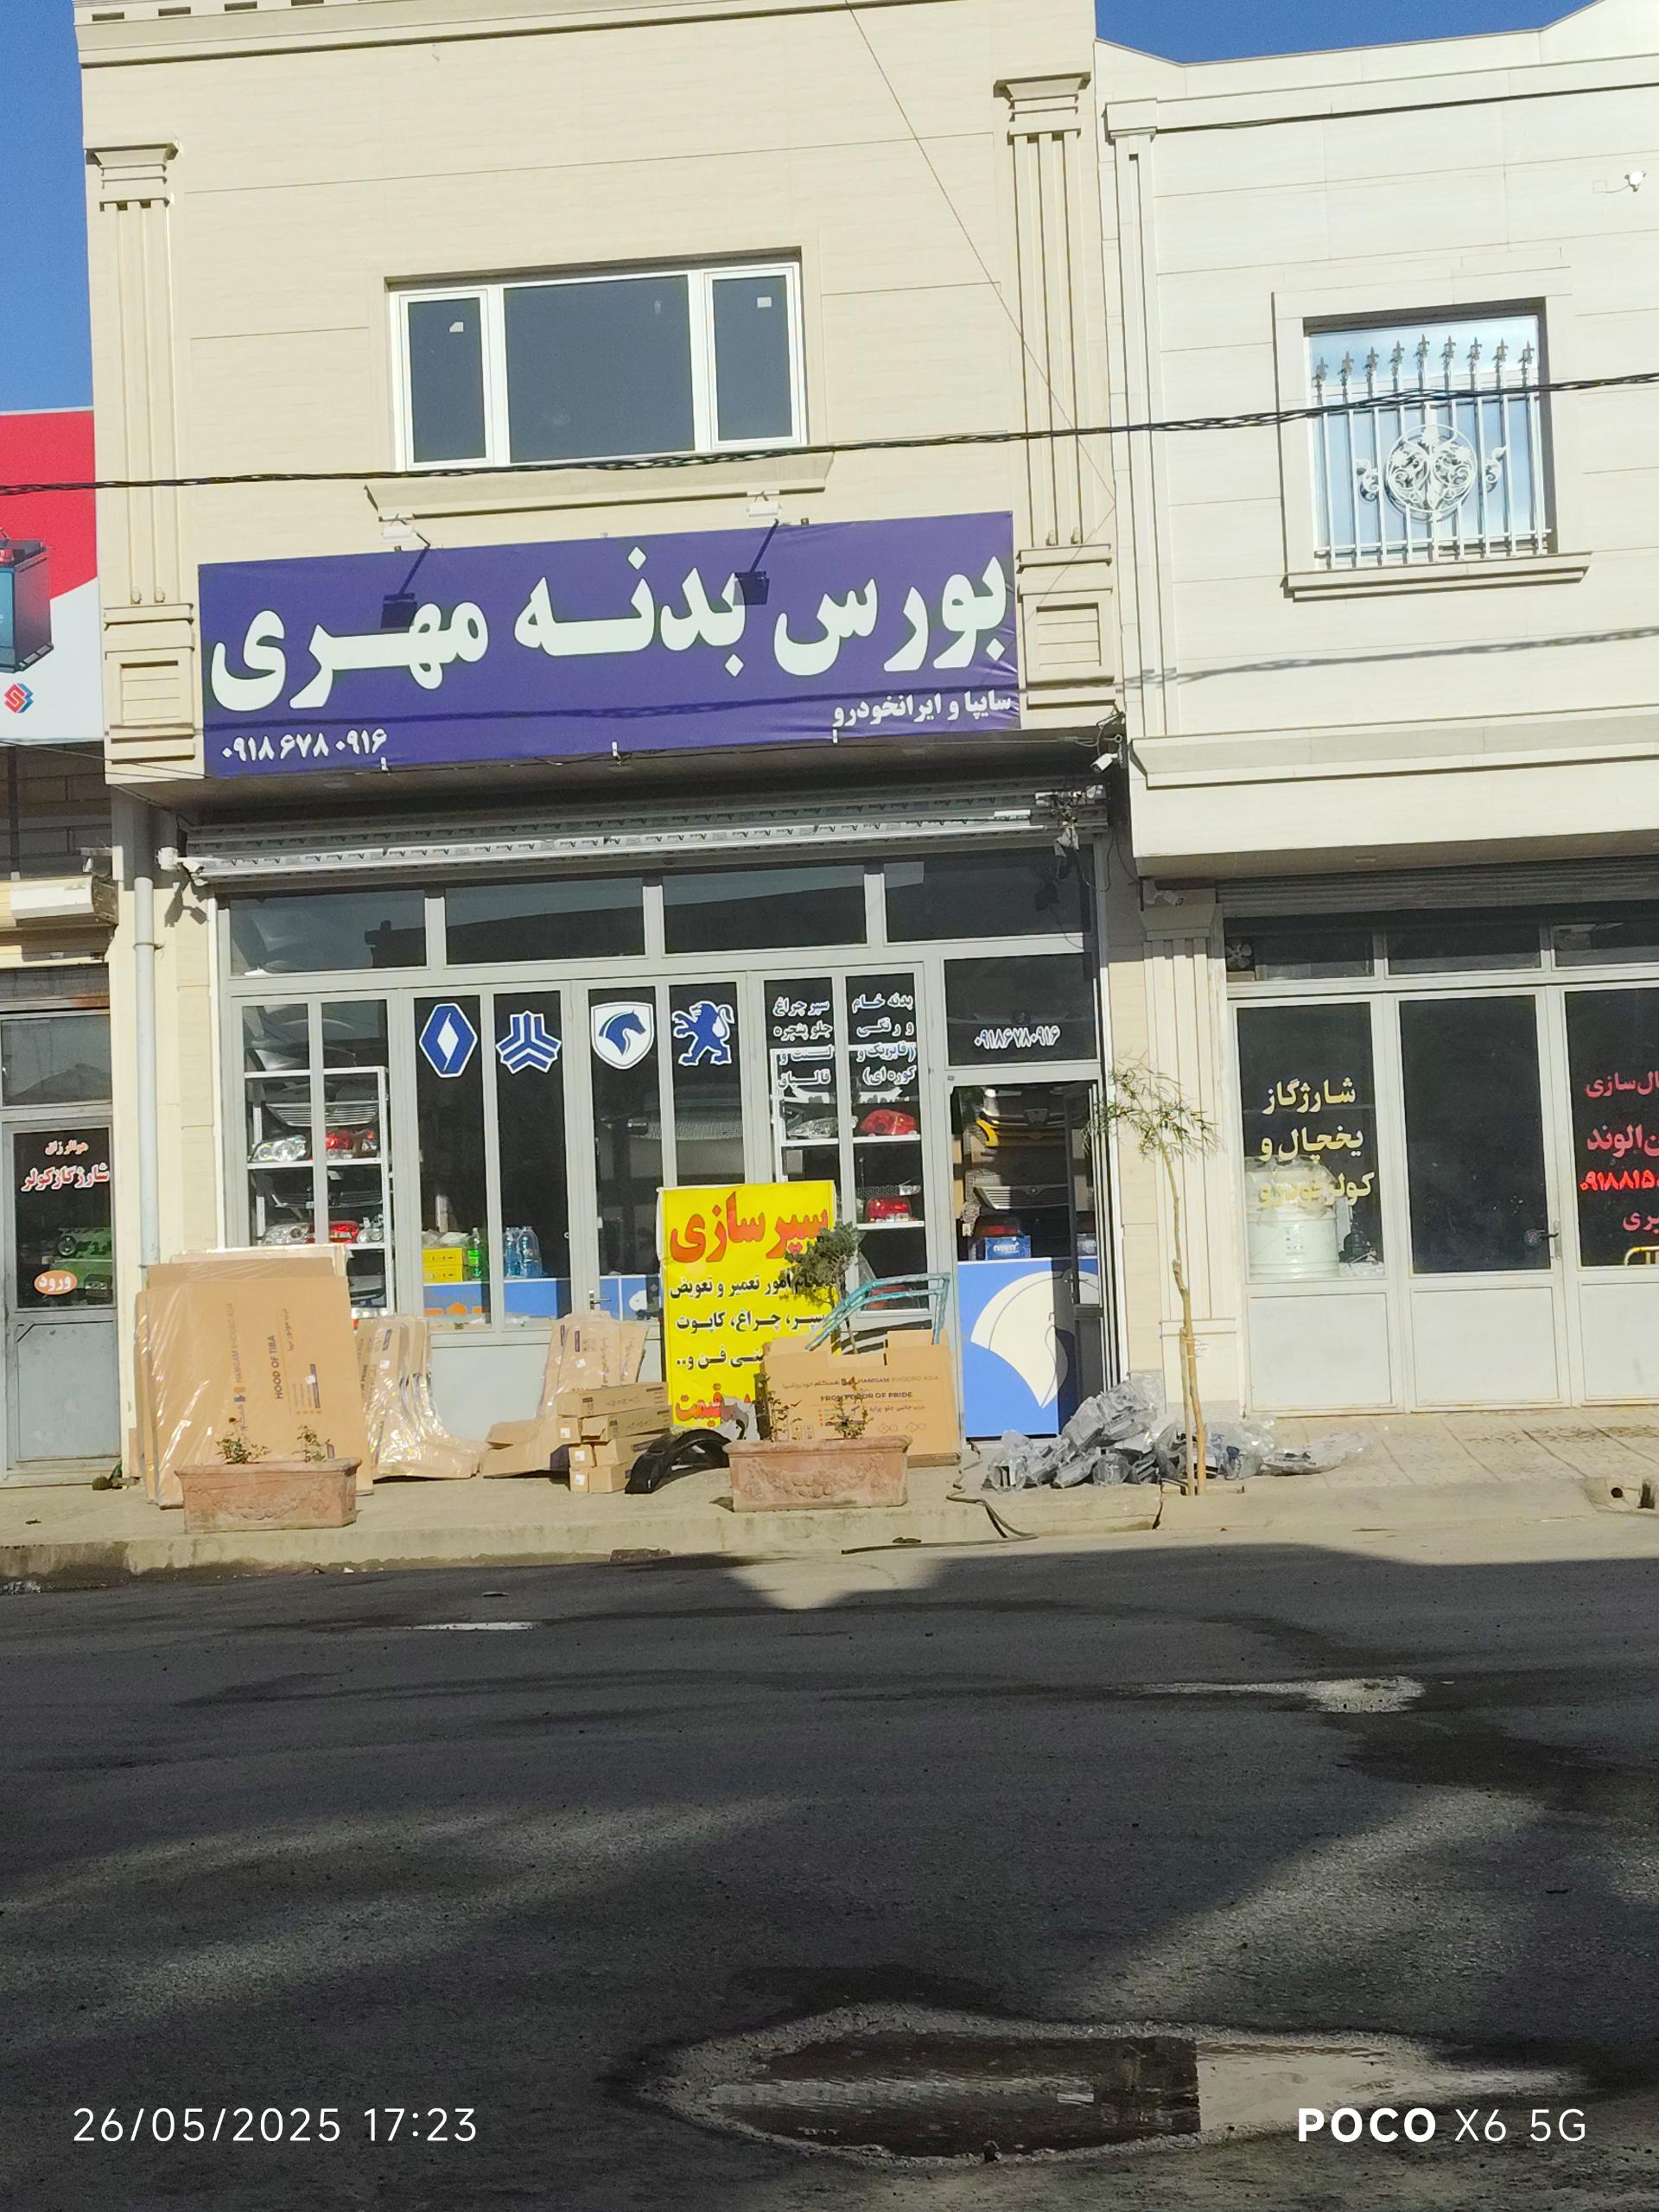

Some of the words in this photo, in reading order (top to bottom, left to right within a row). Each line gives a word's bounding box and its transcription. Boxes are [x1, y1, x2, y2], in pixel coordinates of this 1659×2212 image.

[514, 547, 746, 677] بدنه
[774, 556, 1007, 676] بورس
[211, 601, 489, 711] مهری
[947, 701, 959, 721] و
[964, 690, 1011, 720] سایپا
[772, 996, 807, 1017] چراغ
[852, 993, 886, 1014] خام
[887, 992, 913, 1010] بدنه
[773, 1023, 809, 1041] پنجره
[810, 1020, 833, 1039] جلو
[905, 1021, 914, 1036] و
[1262, 1078, 1300, 1115] گاز
[1297, 1077, 1356, 1113] شارژ
[1258, 1137, 1273, 1161] و
[1278, 1125, 1363, 1164] یخچال
[1586, 1123, 1643, 1158] الوند
[1580, 1169, 1659, 1191] ۰۹۱۸۸۱۵
[670, 1191, 766, 1263] سازی
[766, 1208, 829, 1259] سپر
[38, 1275, 72, 1292] ورود
[670, 1276, 714, 1300] تعویض
[717, 1282, 725, 1298] و
[729, 1274, 760, 1297] تعمیر
[677, 1312, 725, 1334] کاپوت
[697, 1344, 727, 1370] فن
